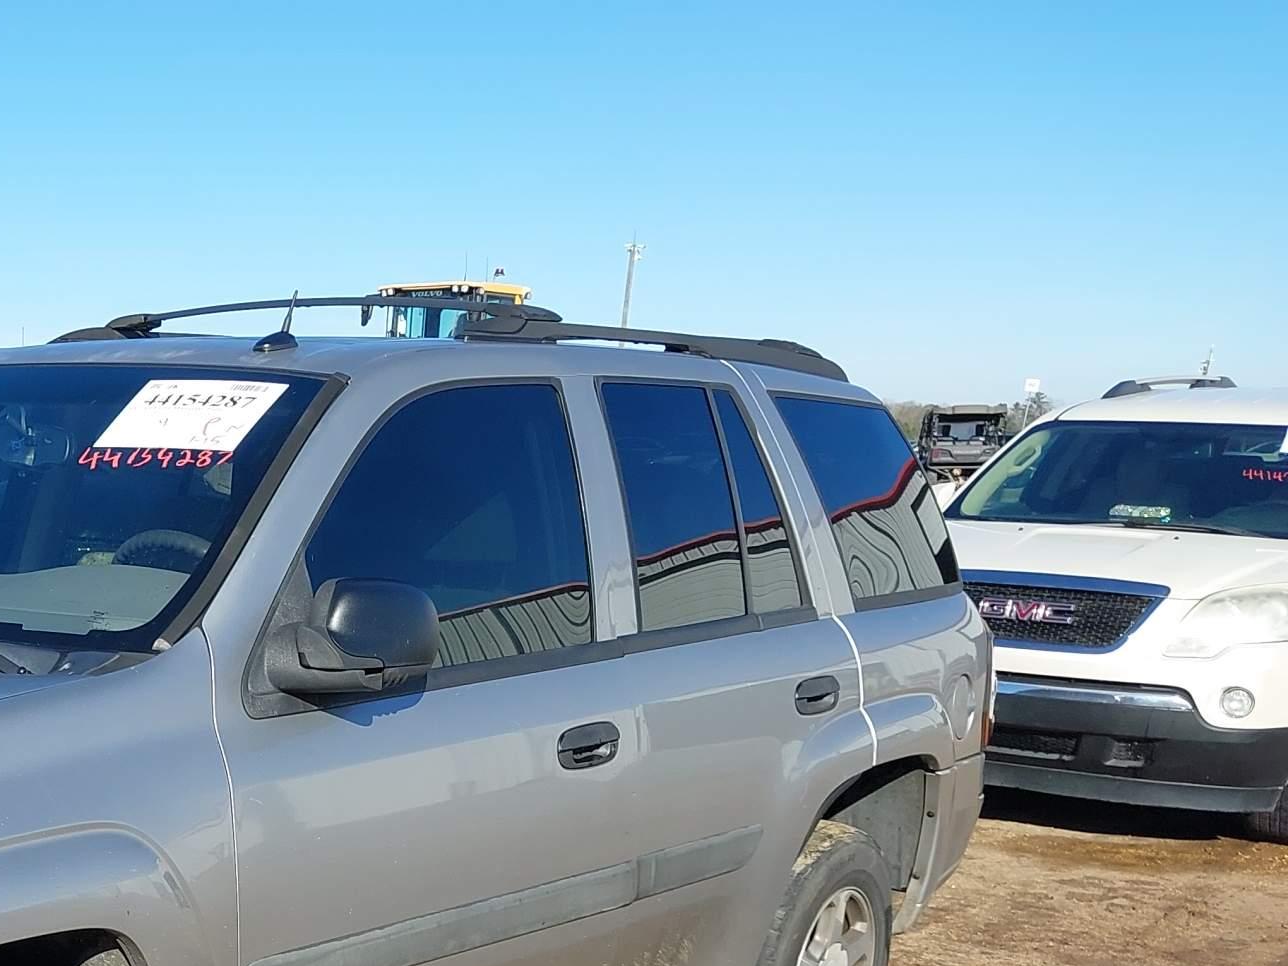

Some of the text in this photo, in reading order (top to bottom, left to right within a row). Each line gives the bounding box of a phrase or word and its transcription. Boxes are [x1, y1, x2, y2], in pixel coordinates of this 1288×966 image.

[144, 393, 256, 408] 44154287
[78, 447, 233, 470] 44154287
[979, 596, 1075, 624] GMC
